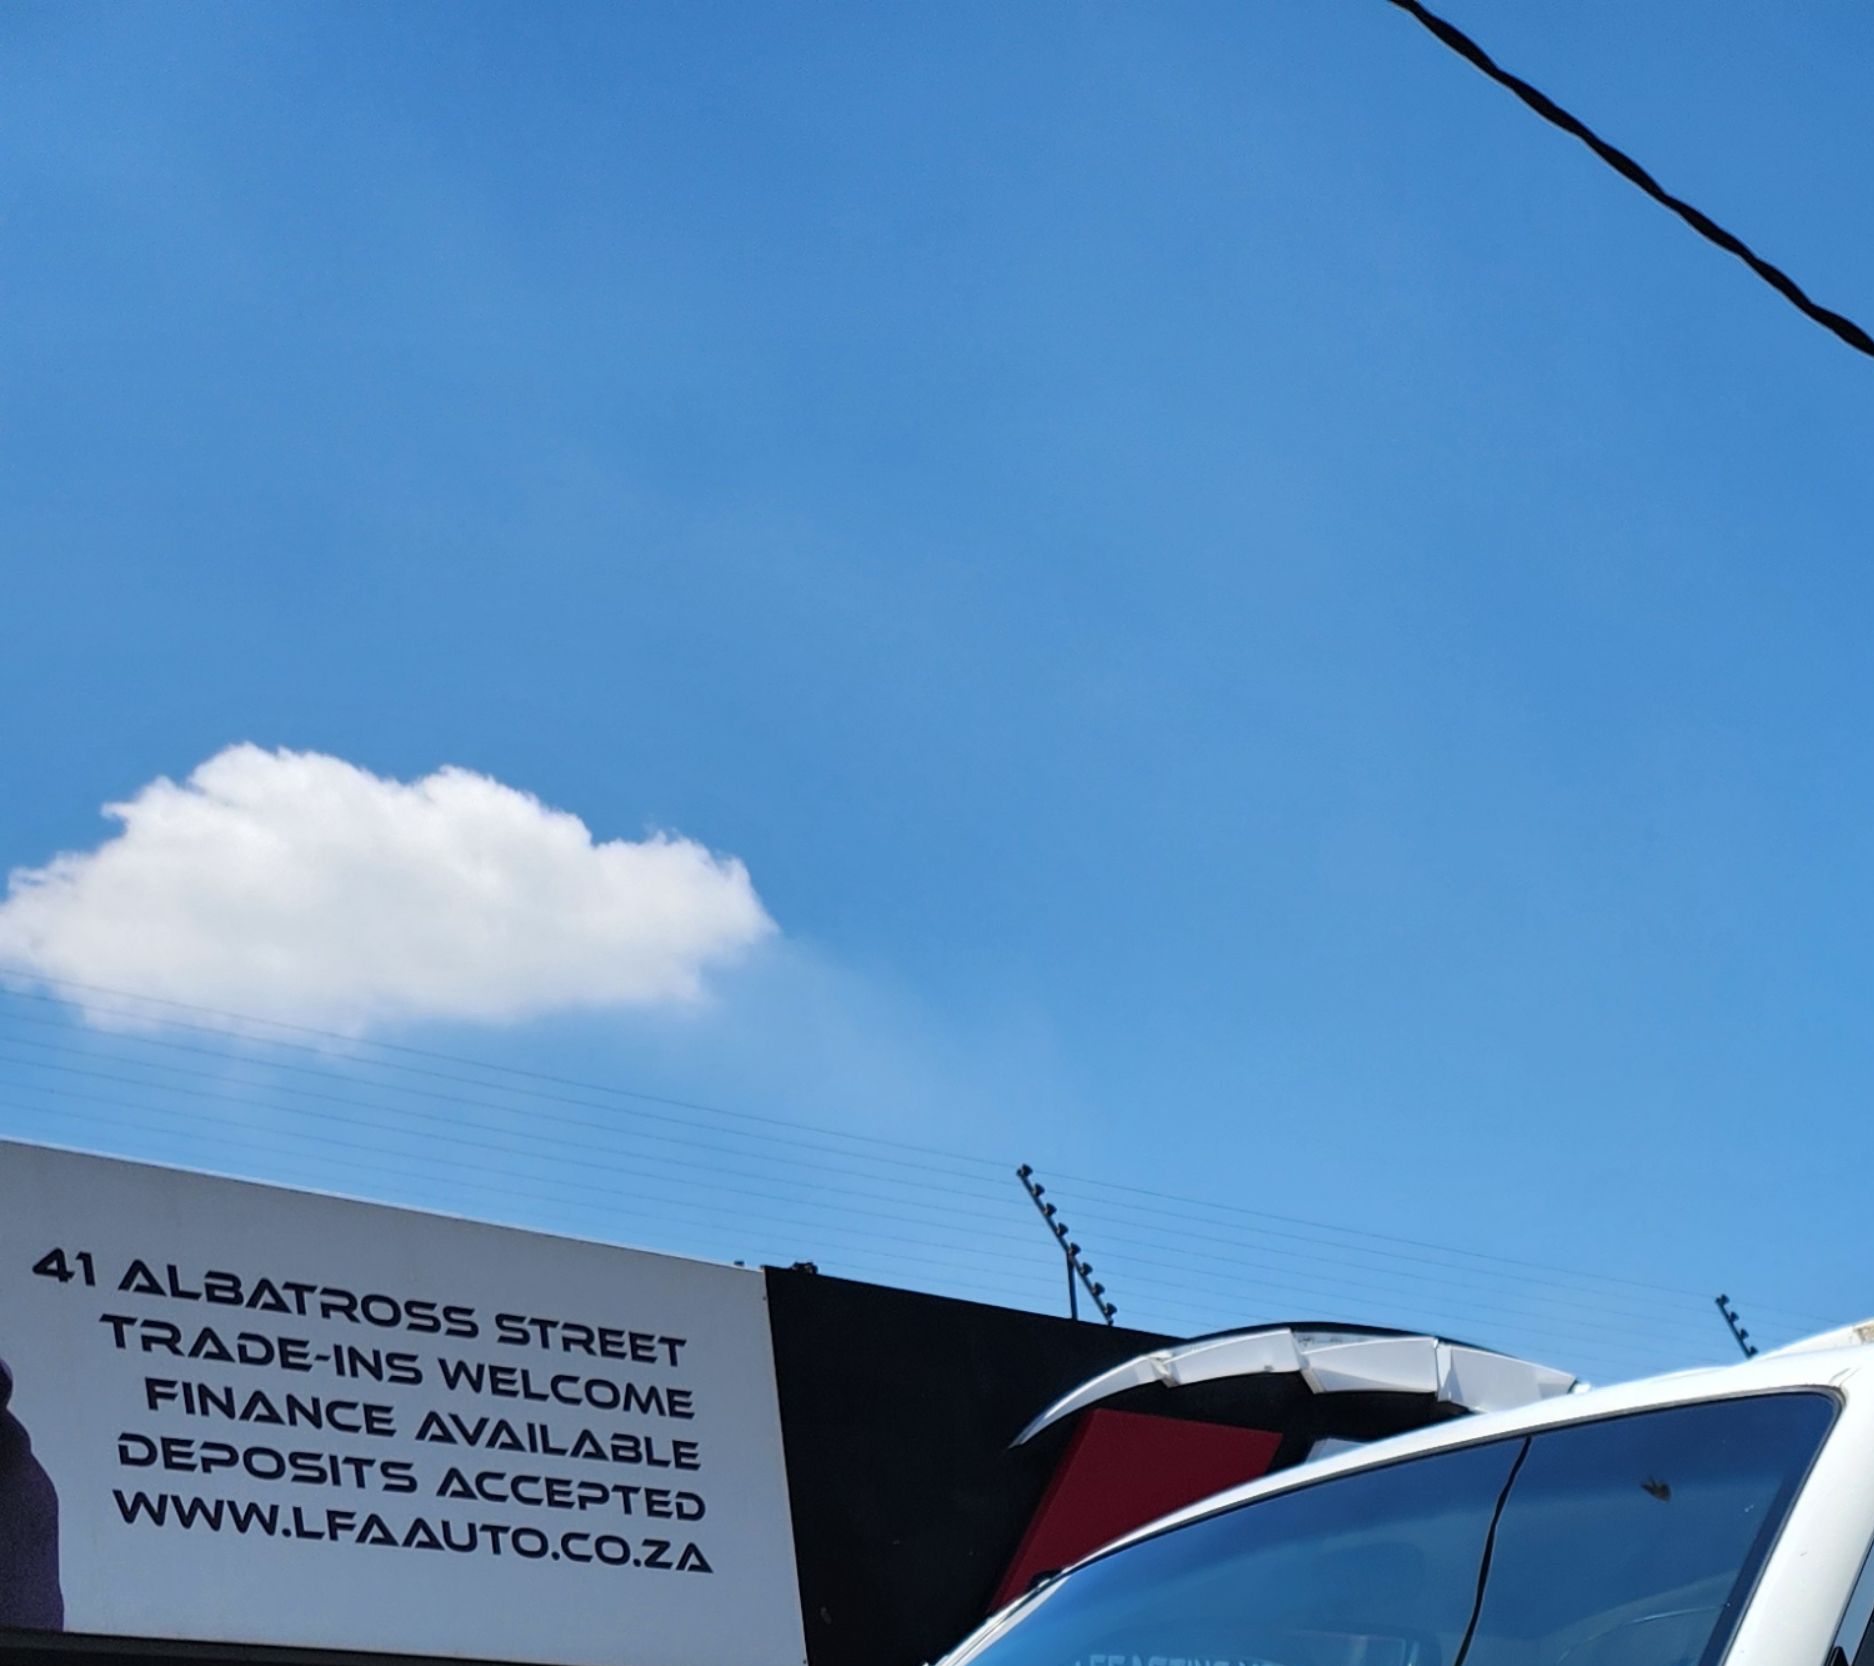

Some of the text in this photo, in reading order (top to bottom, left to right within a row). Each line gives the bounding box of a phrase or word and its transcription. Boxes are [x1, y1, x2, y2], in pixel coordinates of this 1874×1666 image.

[31, 1247, 687, 1368] 41 ALBATROSS STREET
[98, 1313, 695, 1420] TRADE-INS WELCOME
[144, 1376, 701, 1471] FINANCE AVAILABLE
[117, 1432, 706, 1522] DEPOSITS ACCEPTED
[112, 1489, 714, 1574] WWW.LFAAUTO.CO.ZA
